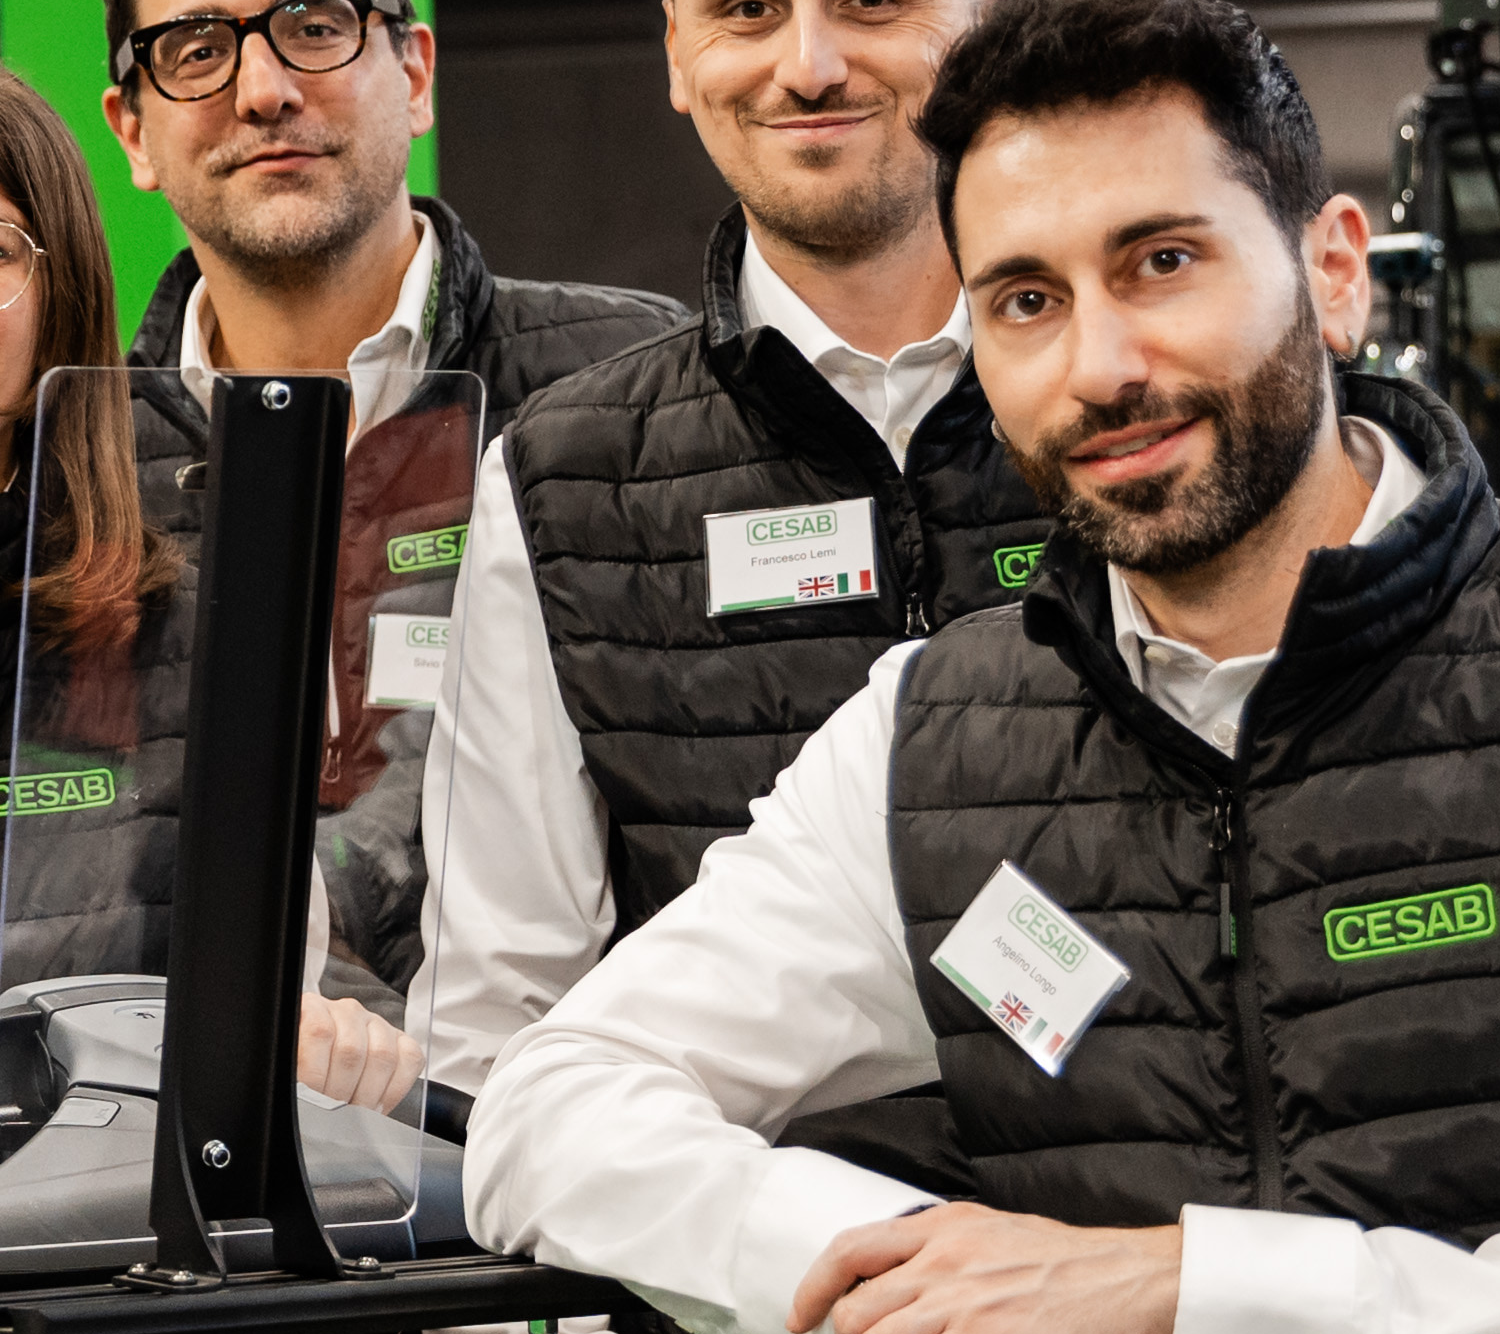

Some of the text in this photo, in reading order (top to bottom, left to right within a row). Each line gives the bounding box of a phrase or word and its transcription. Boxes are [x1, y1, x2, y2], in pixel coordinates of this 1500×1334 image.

[752, 514, 832, 541] CESAB
[393, 531, 468, 567] CES
[751, 547, 837, 567] Francesco Lemi
[411, 626, 450, 645] CES
[1015, 902, 1081, 966] CESAB
[1335, 894, 1486, 951] CESAB
[992, 935, 1057, 996] Angelino Longo
